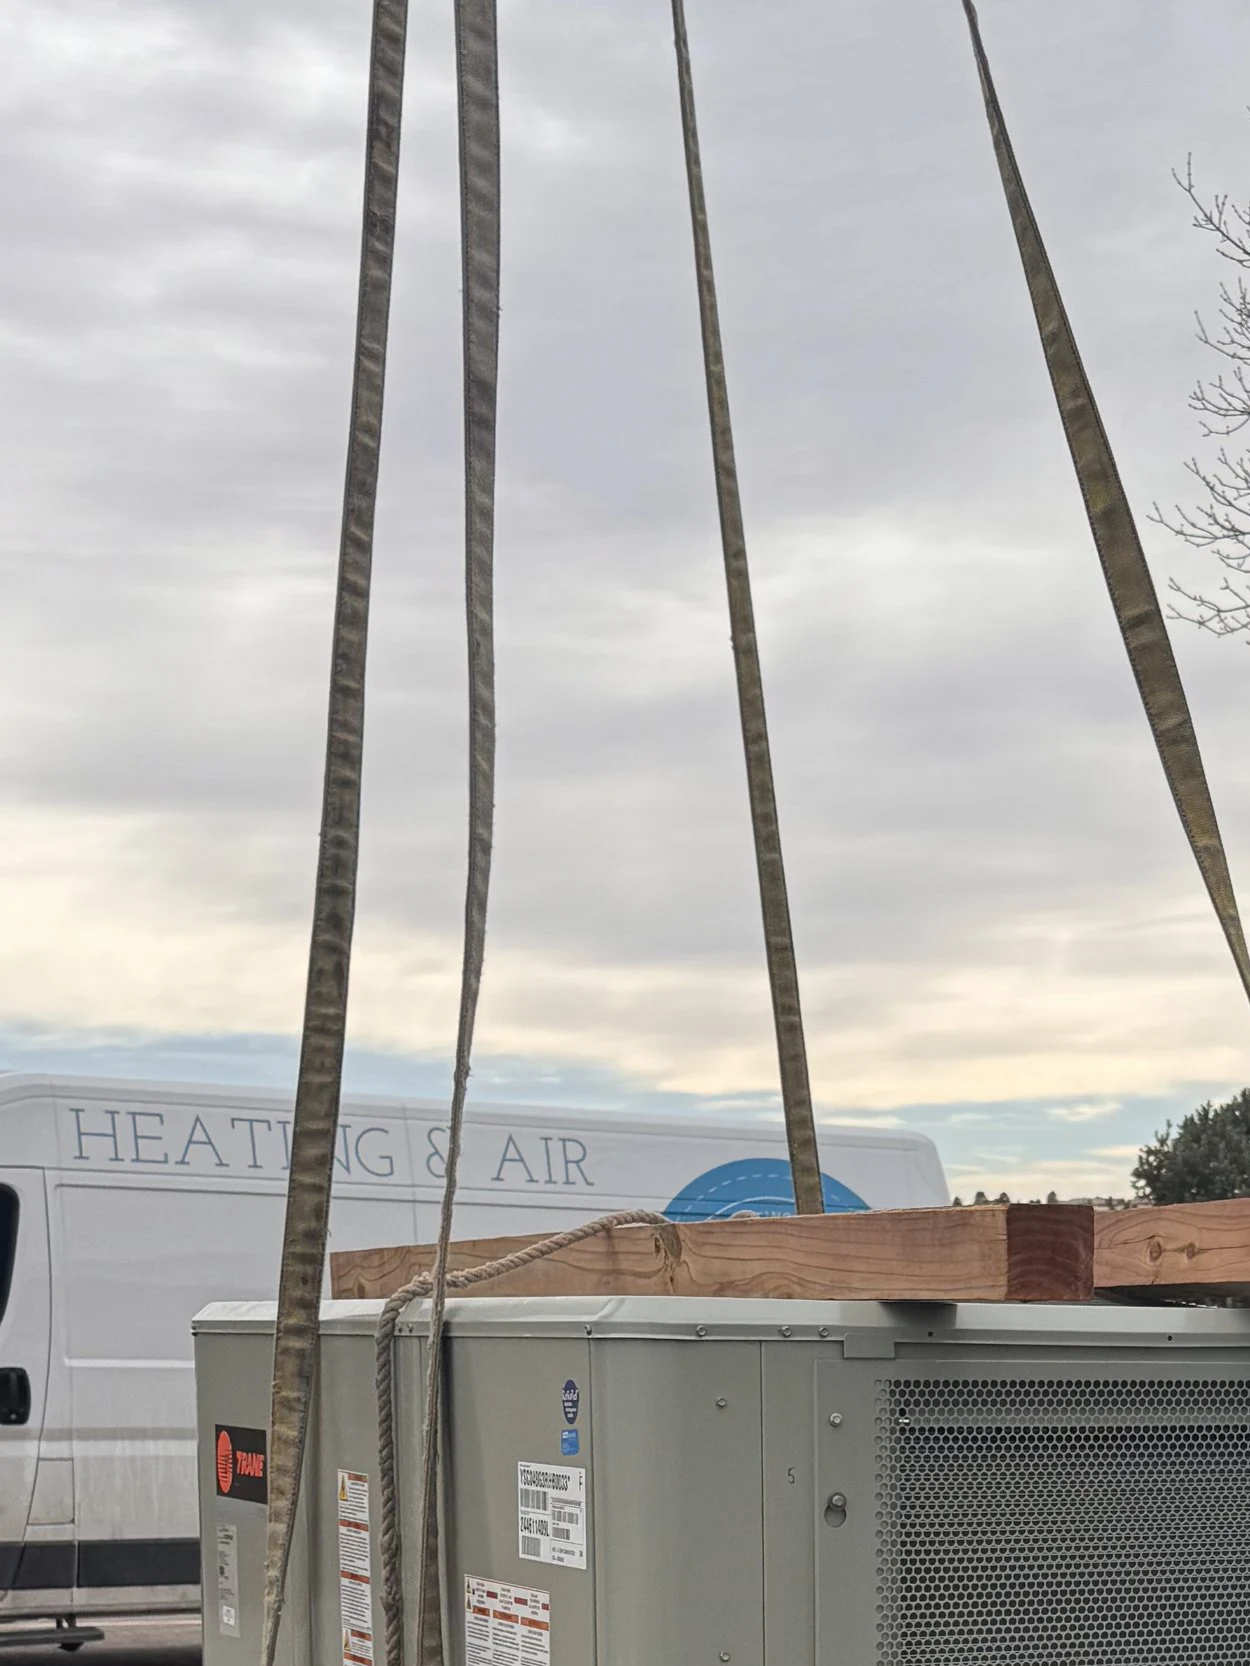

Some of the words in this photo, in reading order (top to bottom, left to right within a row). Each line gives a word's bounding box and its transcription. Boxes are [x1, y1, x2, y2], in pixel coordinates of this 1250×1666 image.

[425, 1126, 451, 1178] &
[489, 1132, 595, 1186] AIR
[236, 1450, 265, 1478] TRANE
